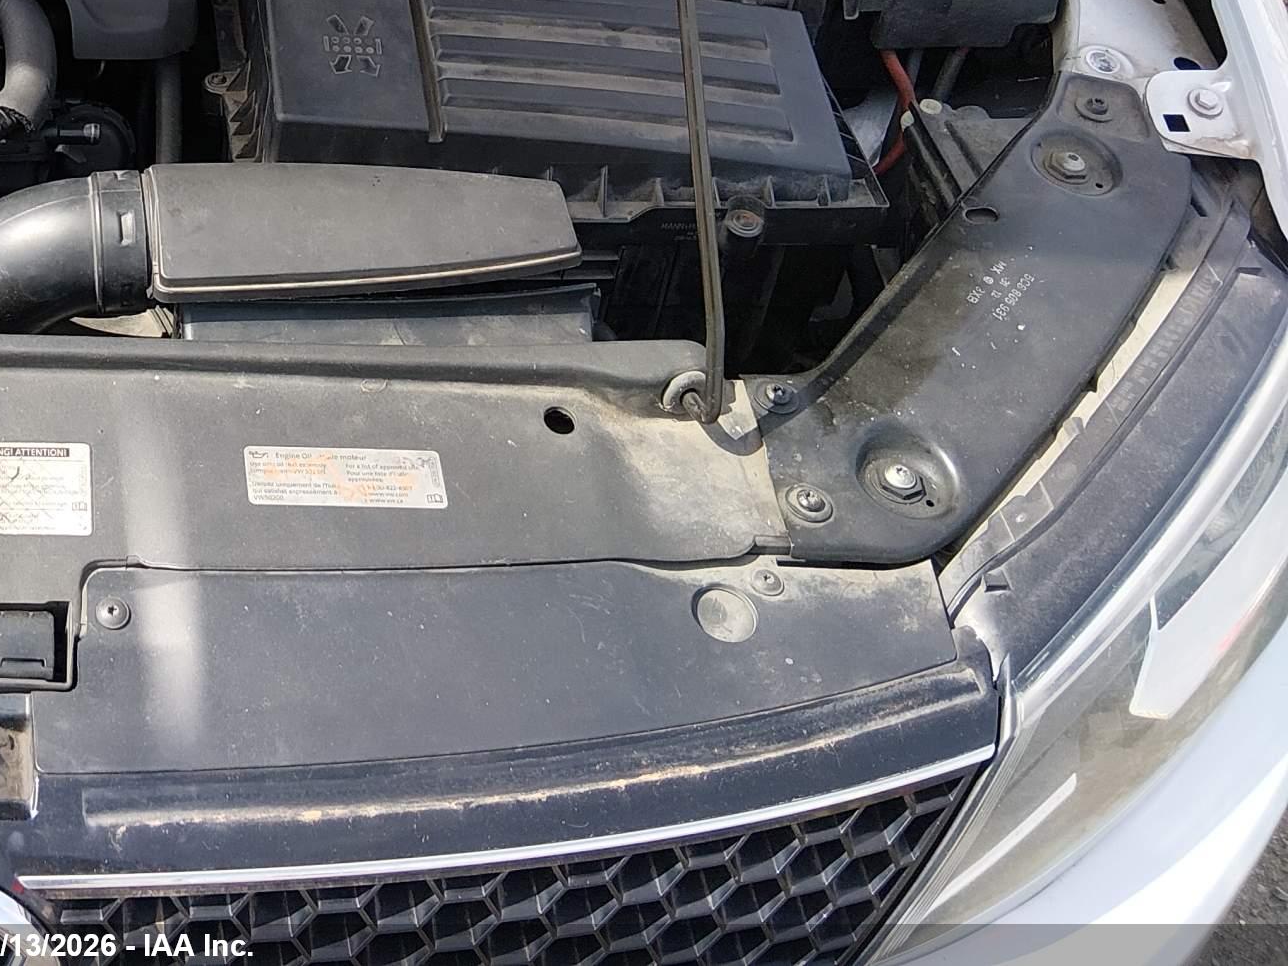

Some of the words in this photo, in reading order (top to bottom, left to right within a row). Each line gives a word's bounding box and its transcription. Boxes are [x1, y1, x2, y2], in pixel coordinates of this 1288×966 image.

[990, 260, 1007, 274] MX
[1017, 273, 1035, 291] 5C6
[1005, 288, 1022, 306] 805
[992, 303, 1010, 321] 931
[15, 448, 68, 457] ATTENTION!
[275, 452, 300, 460] Engine
[340, 454, 367, 462] moteur
